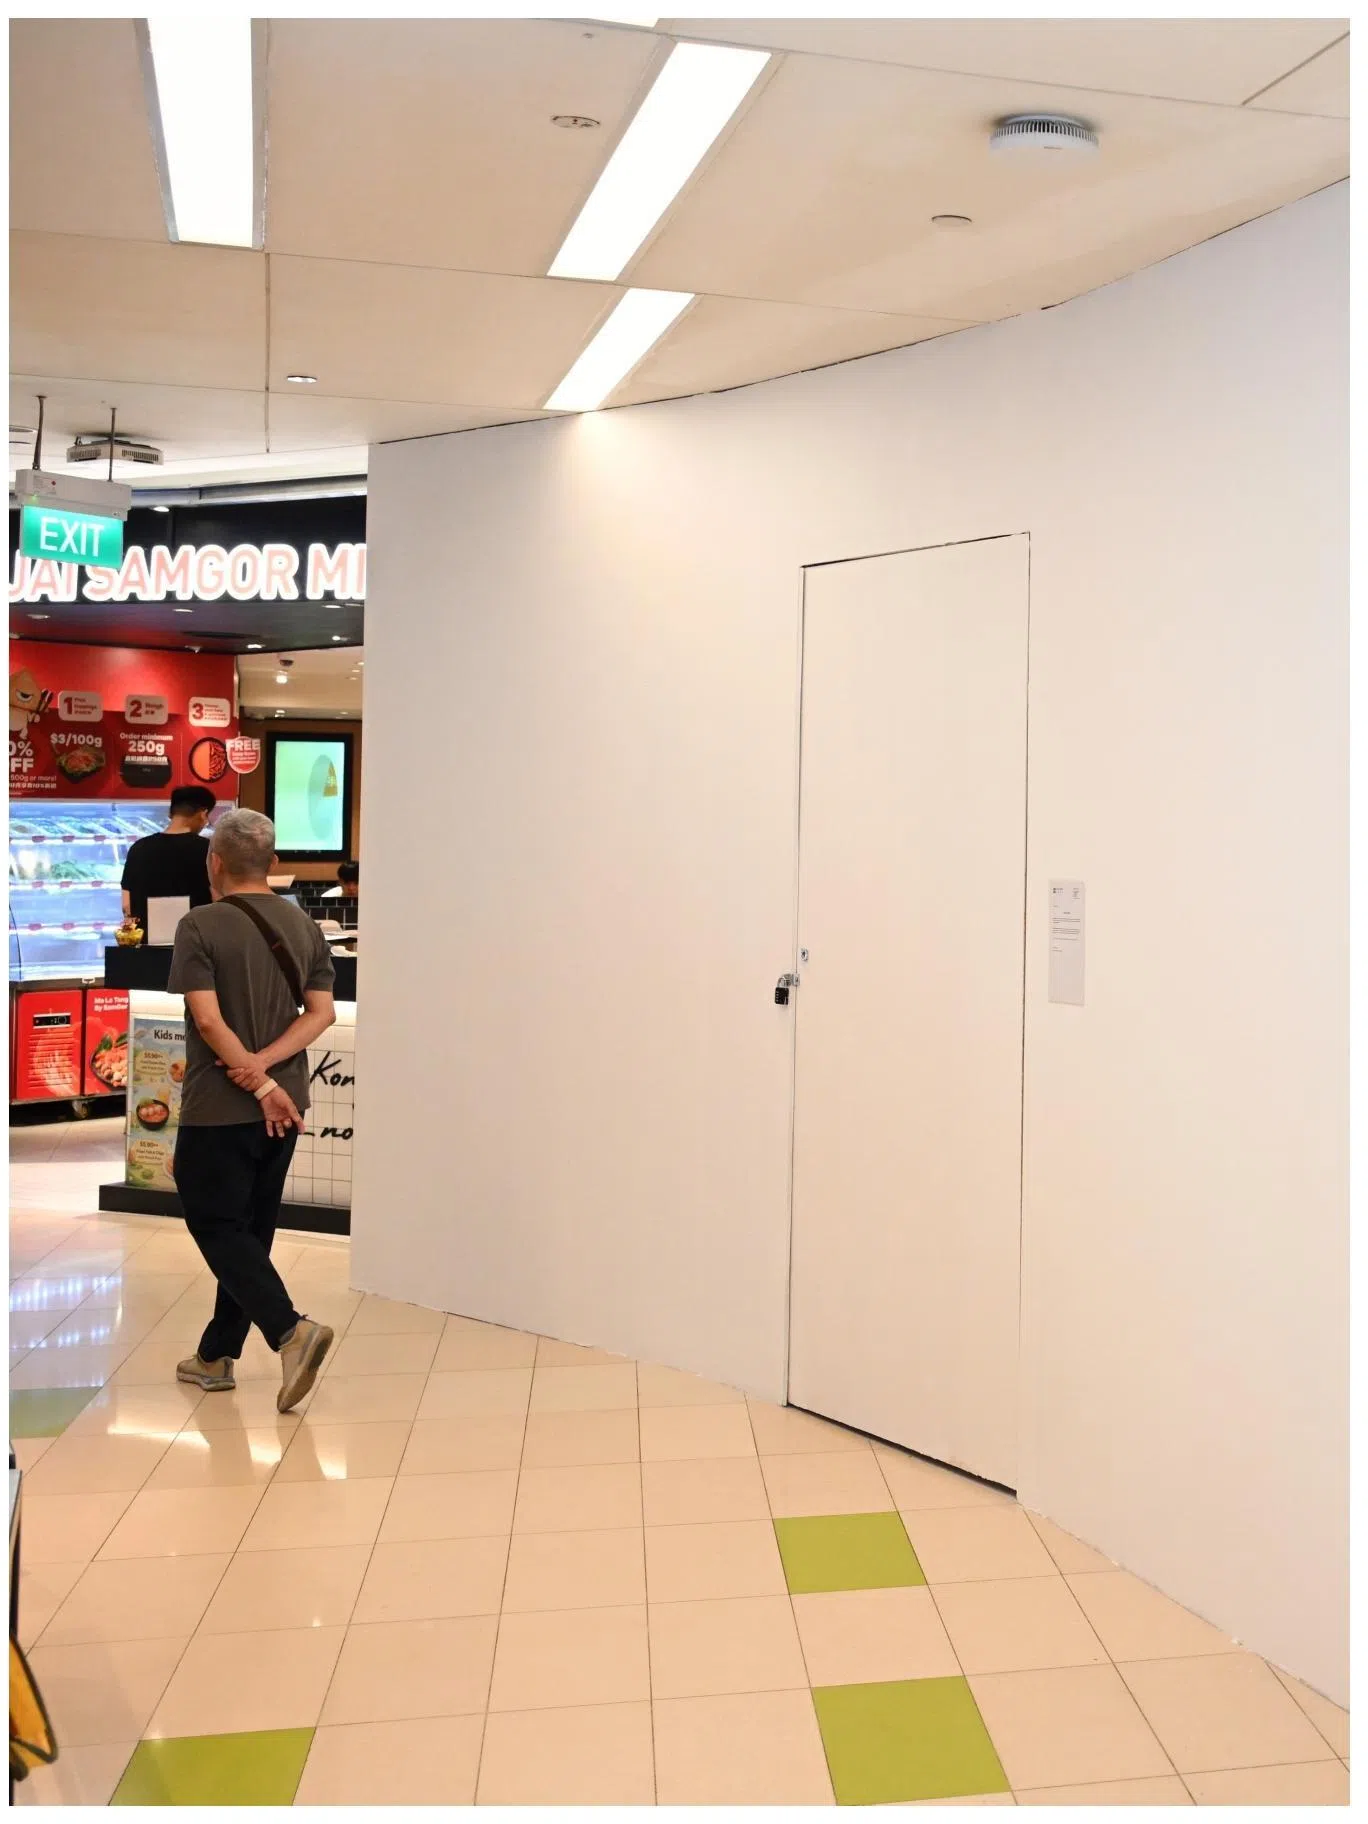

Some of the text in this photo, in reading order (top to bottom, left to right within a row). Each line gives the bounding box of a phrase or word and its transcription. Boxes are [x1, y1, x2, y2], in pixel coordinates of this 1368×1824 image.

[39, 516, 105, 557] EXIT
[82, 544, 299, 602] SAMGOR
[63, 696, 73, 715] 1
[129, 699, 142, 718] 2
[192, 702, 204, 720] 3
[50, 732, 103, 748] $3/100g
[119, 732, 174, 742] Order minimum
[225, 738, 261, 752] FREE
[128, 740, 166, 756] 250g
[153, 1029, 173, 1041] Kids
